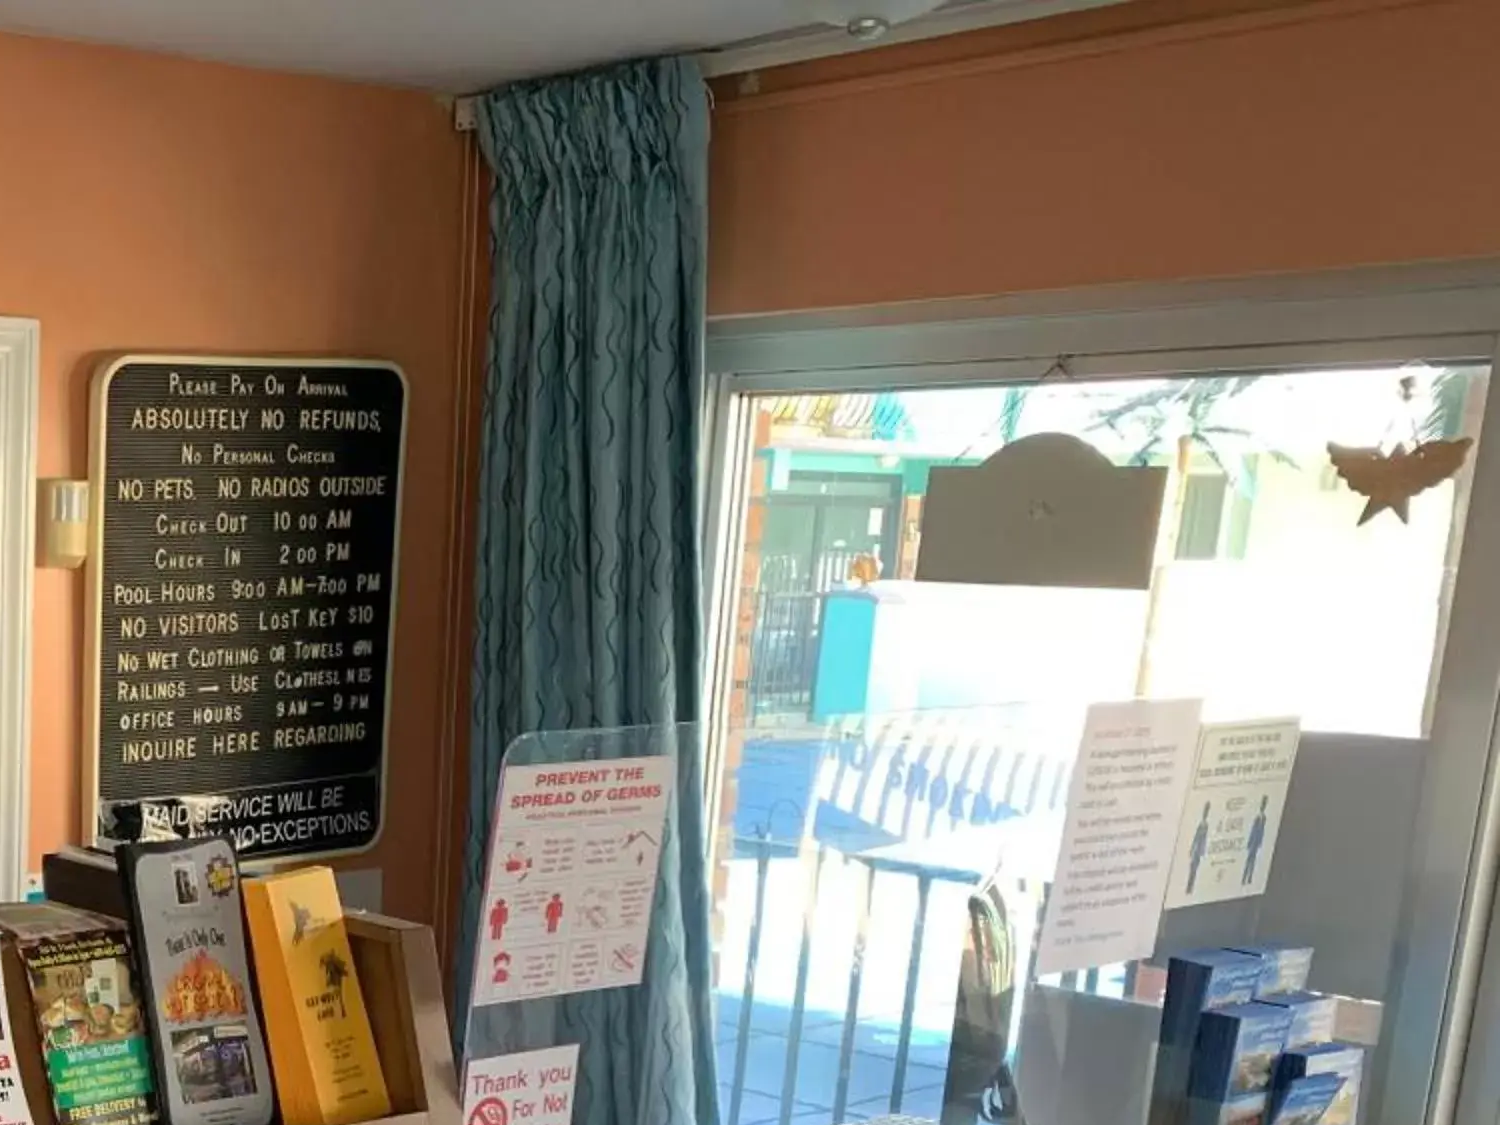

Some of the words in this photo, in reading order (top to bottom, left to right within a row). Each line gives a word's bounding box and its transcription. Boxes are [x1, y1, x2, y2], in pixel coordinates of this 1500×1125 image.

[231, 373, 254, 396] PAY
[264, 375, 285, 396] ON
[297, 375, 348, 397] ARRIVAL
[131, 408, 249, 431] ABSOLUTELY
[261, 409, 285, 430] NO
[180, 444, 201, 464] NO
[213, 443, 276, 465] PERSONAL
[286, 443, 335, 464] CHECKS
[117, 479, 143, 501] NO
[218, 478, 241, 498] NO
[250, 476, 309, 497] RADIOS
[319, 476, 387, 496] OUTSIDE
[156, 513, 207, 536] CHECK
[216, 512, 248, 534] OUT
[326, 509, 352, 529] AM
[155, 548, 204, 569] CHECK
[225, 547, 241, 567] IN
[326, 542, 350, 562] PM
[114, 583, 153, 605] POOL
[160, 579, 215, 601] HOURS
[357, 574, 381, 592] PM
[120, 617, 146, 639] NO
[159, 611, 240, 636] VISITORS
[258, 610, 300, 632] LOST
[308, 605, 340, 628] KEY
[117, 653, 139, 674] NO
[147, 651, 181, 671] WET
[187, 645, 260, 669] CLOTHING
[293, 640, 343, 661] TOWELS
[116, 680, 187, 702] RAILINGS
[230, 674, 260, 694] USE
[120, 710, 175, 731] OFFICE
[192, 704, 244, 724] HOURS
[212, 731, 261, 756] HERE
[273, 722, 367, 750] REGARDING
[534, 768, 612, 788] PREVENT
[614, 766, 646, 780] THE
[196, 795, 273, 824] SERVICE
[277, 789, 318, 814] WILL
[320, 785, 346, 807] BE
[509, 791, 577, 810] SPREAD
[581, 789, 602, 804] OF
[606, 784, 663, 801] GERMS
[471, 1069, 529, 1096] Thank
[538, 1065, 573, 1091] you
[512, 1098, 538, 1120] For
[542, 1091, 569, 1114] Not
